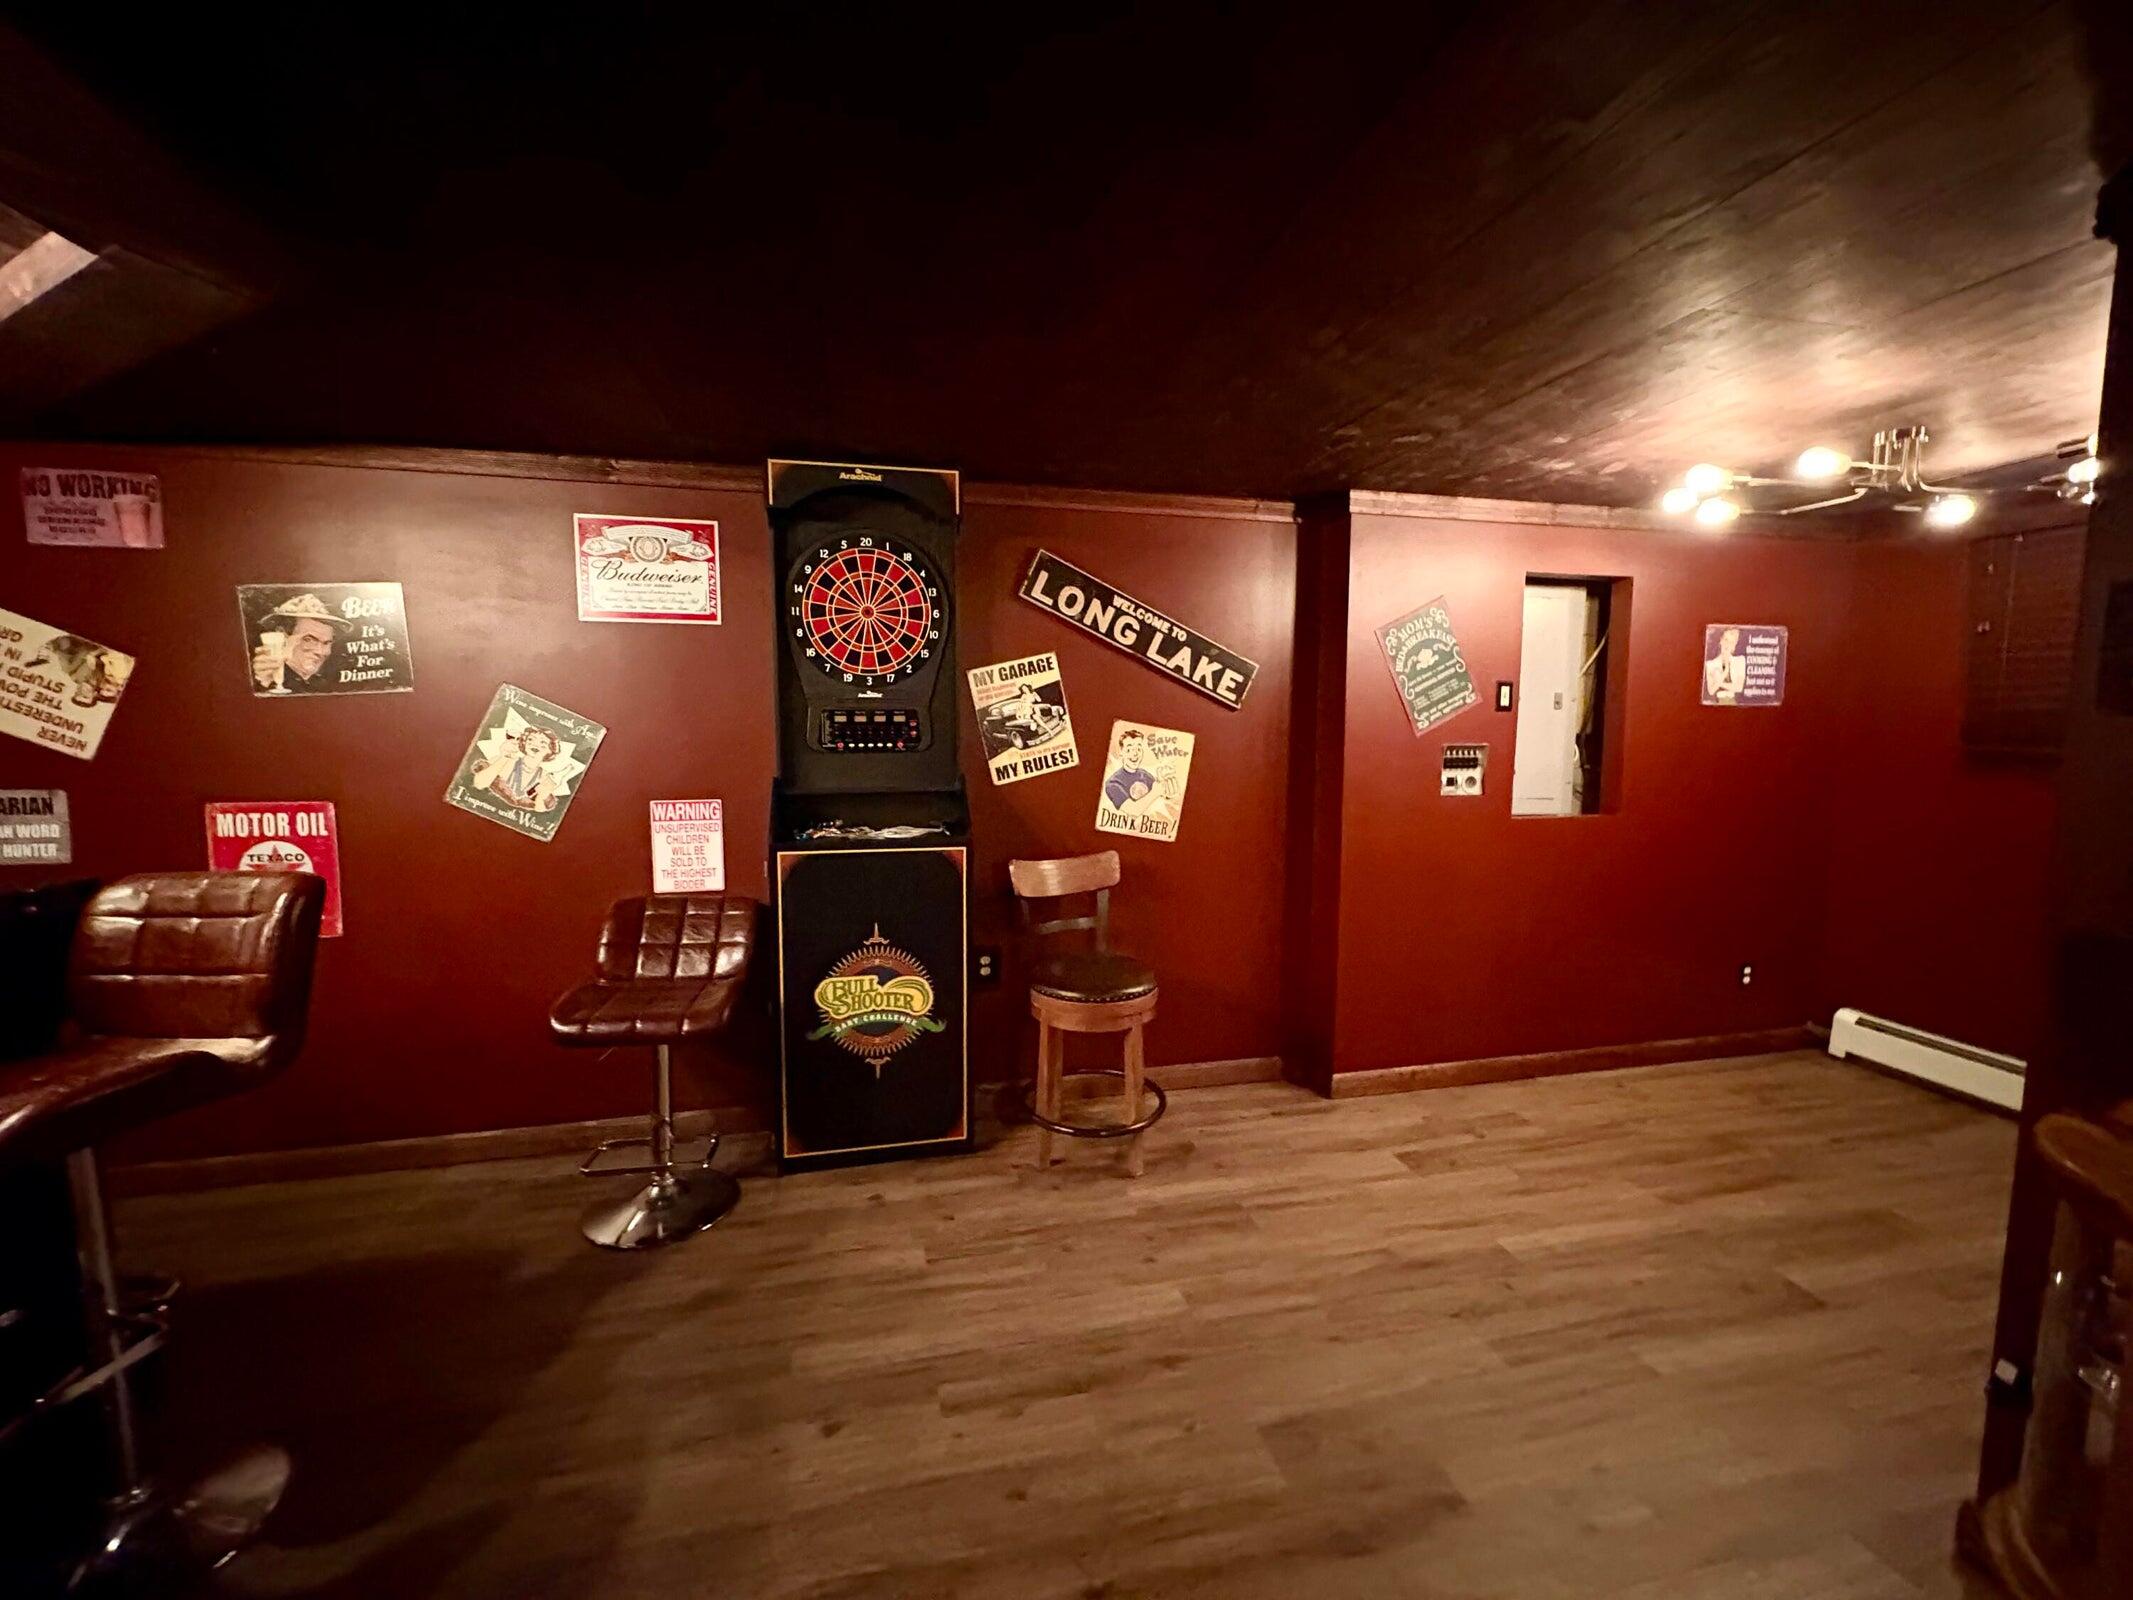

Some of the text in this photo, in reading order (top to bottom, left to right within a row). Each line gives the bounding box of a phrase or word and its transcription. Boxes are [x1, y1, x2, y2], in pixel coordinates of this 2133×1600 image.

[56, 474, 158, 503] WORKING
[841, 540, 848, 549] 5
[860, 538, 872, 546] 20
[886, 542, 890, 550] 1
[820, 550, 828, 558] 12
[904, 552, 912, 562] 18
[591, 559, 702, 584] Budweiser
[805, 565, 812, 574] 9
[920, 570, 926, 578] 4
[794, 585, 803, 593] 14
[928, 588, 936, 596] 13
[792, 607, 800, 616] 11
[933, 610, 940, 618] 6
[1112, 594, 1187, 642] WELCOME TO
[362, 625, 385, 638] It's
[796, 629, 803, 638] 8
[930, 630, 938, 639] 10
[1030, 570, 1244, 701] LONG LAKE
[346, 638, 396, 654] What's
[4, 646, 23, 661] IN
[806, 648, 816, 656] 16
[921, 650, 929, 658] 15
[356, 655, 384, 668] For
[825, 664, 830, 672] 7
[906, 664, 912, 673] 2
[972, 669, 996, 688] MY
[998, 656, 1055, 682] GARAGE
[7, 666, 66, 693] STUPID
[338, 668, 394, 683] Dinner
[844, 674, 852, 682] 19
[886, 674, 894, 682] 17
[866, 677, 872, 686] 3
[31, 691, 62, 710] THE
[504, 688, 527, 708] Wine
[36, 726, 88, 752] NEVER
[1147, 733, 1178, 748] Save
[1150, 745, 1189, 760] Water
[995, 748, 1075, 782] MY RULES!
[652, 801, 720, 821] WARNING
[216, 812, 329, 838] MOTOR OIL
[1100, 808, 1137, 831] DRINK
[15, 824, 60, 838] WORD
[655, 823, 719, 833] UNSUPERVISED
[666, 835, 709, 845] CHILDREN
[2, 843, 57, 858] HUNTER
[672, 845, 705, 856] WILL BE
[246, 853, 305, 863] TEXACO
[670, 857, 707, 867] SOLD TO
[661, 867, 717, 879] THE HIGHEST
[674, 879, 706, 890] BIDDER
[832, 977, 879, 1001] BULL
[833, 992, 916, 1015] SHOOTER
